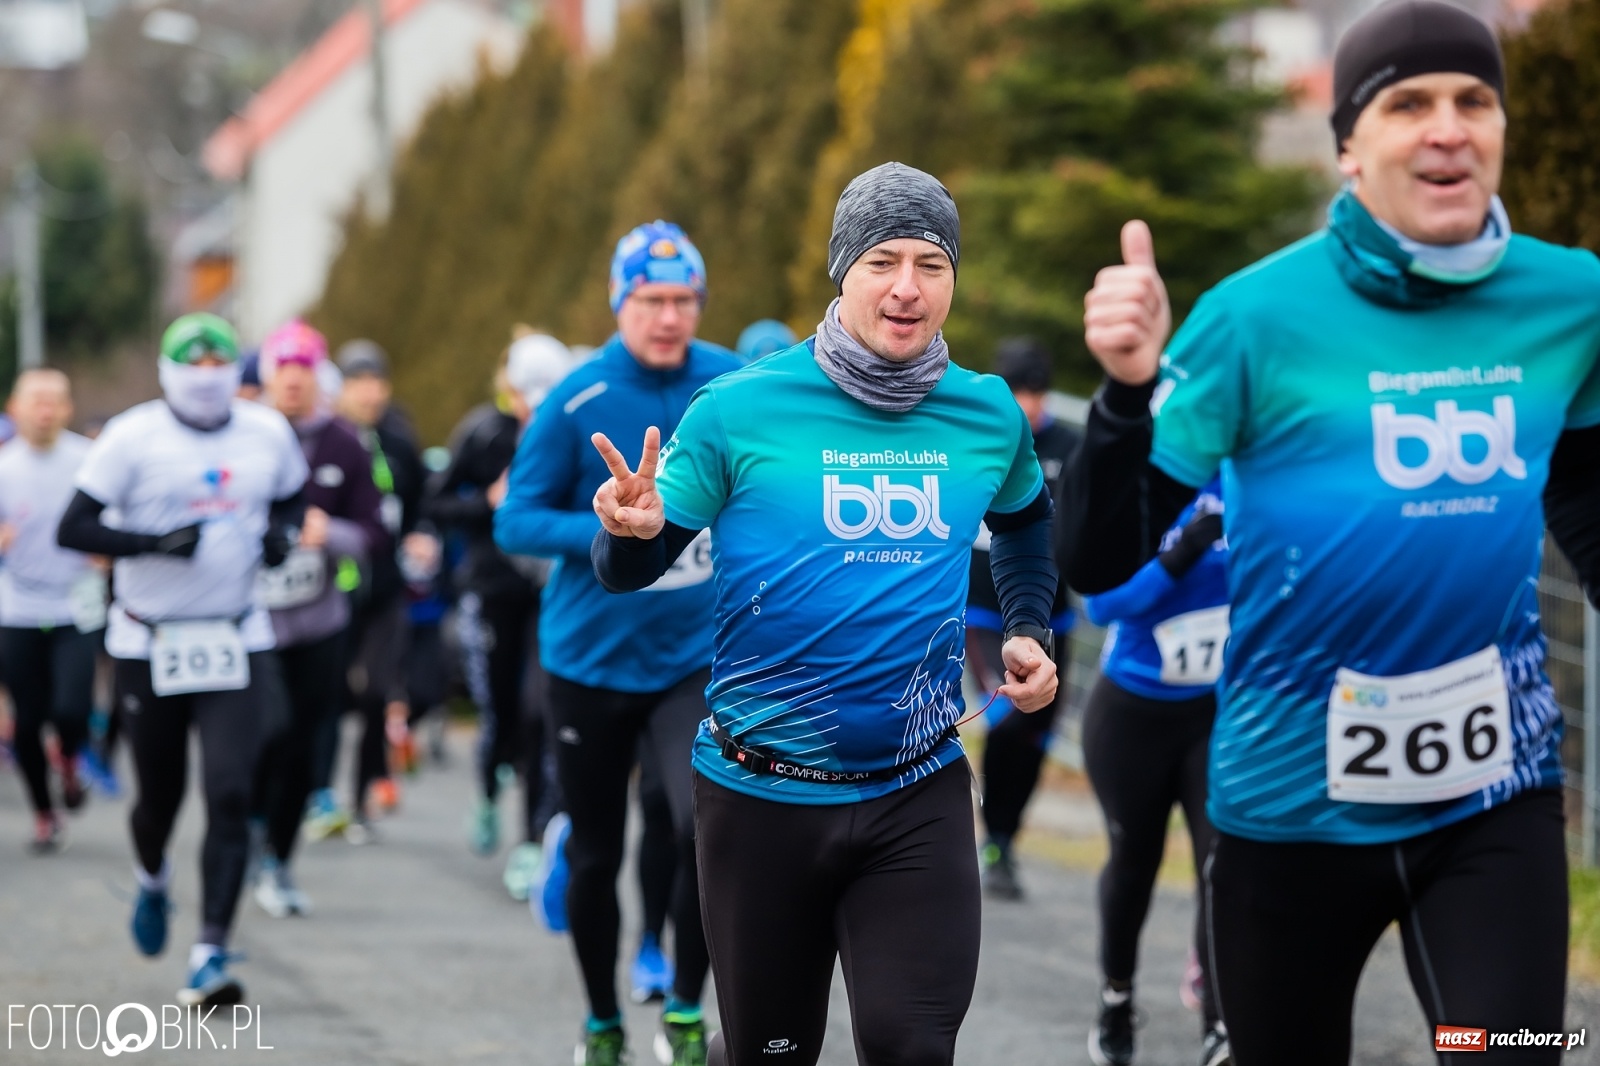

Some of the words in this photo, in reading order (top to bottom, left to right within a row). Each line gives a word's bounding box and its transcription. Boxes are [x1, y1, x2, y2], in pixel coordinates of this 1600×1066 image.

[822, 449, 948, 468] BiegamBoLubię
[1371, 395, 1528, 490] bbl
[823, 474, 951, 540] bbl
[843, 548, 923, 564] RACIBÓRZ
[1343, 704, 1499, 777] 266
